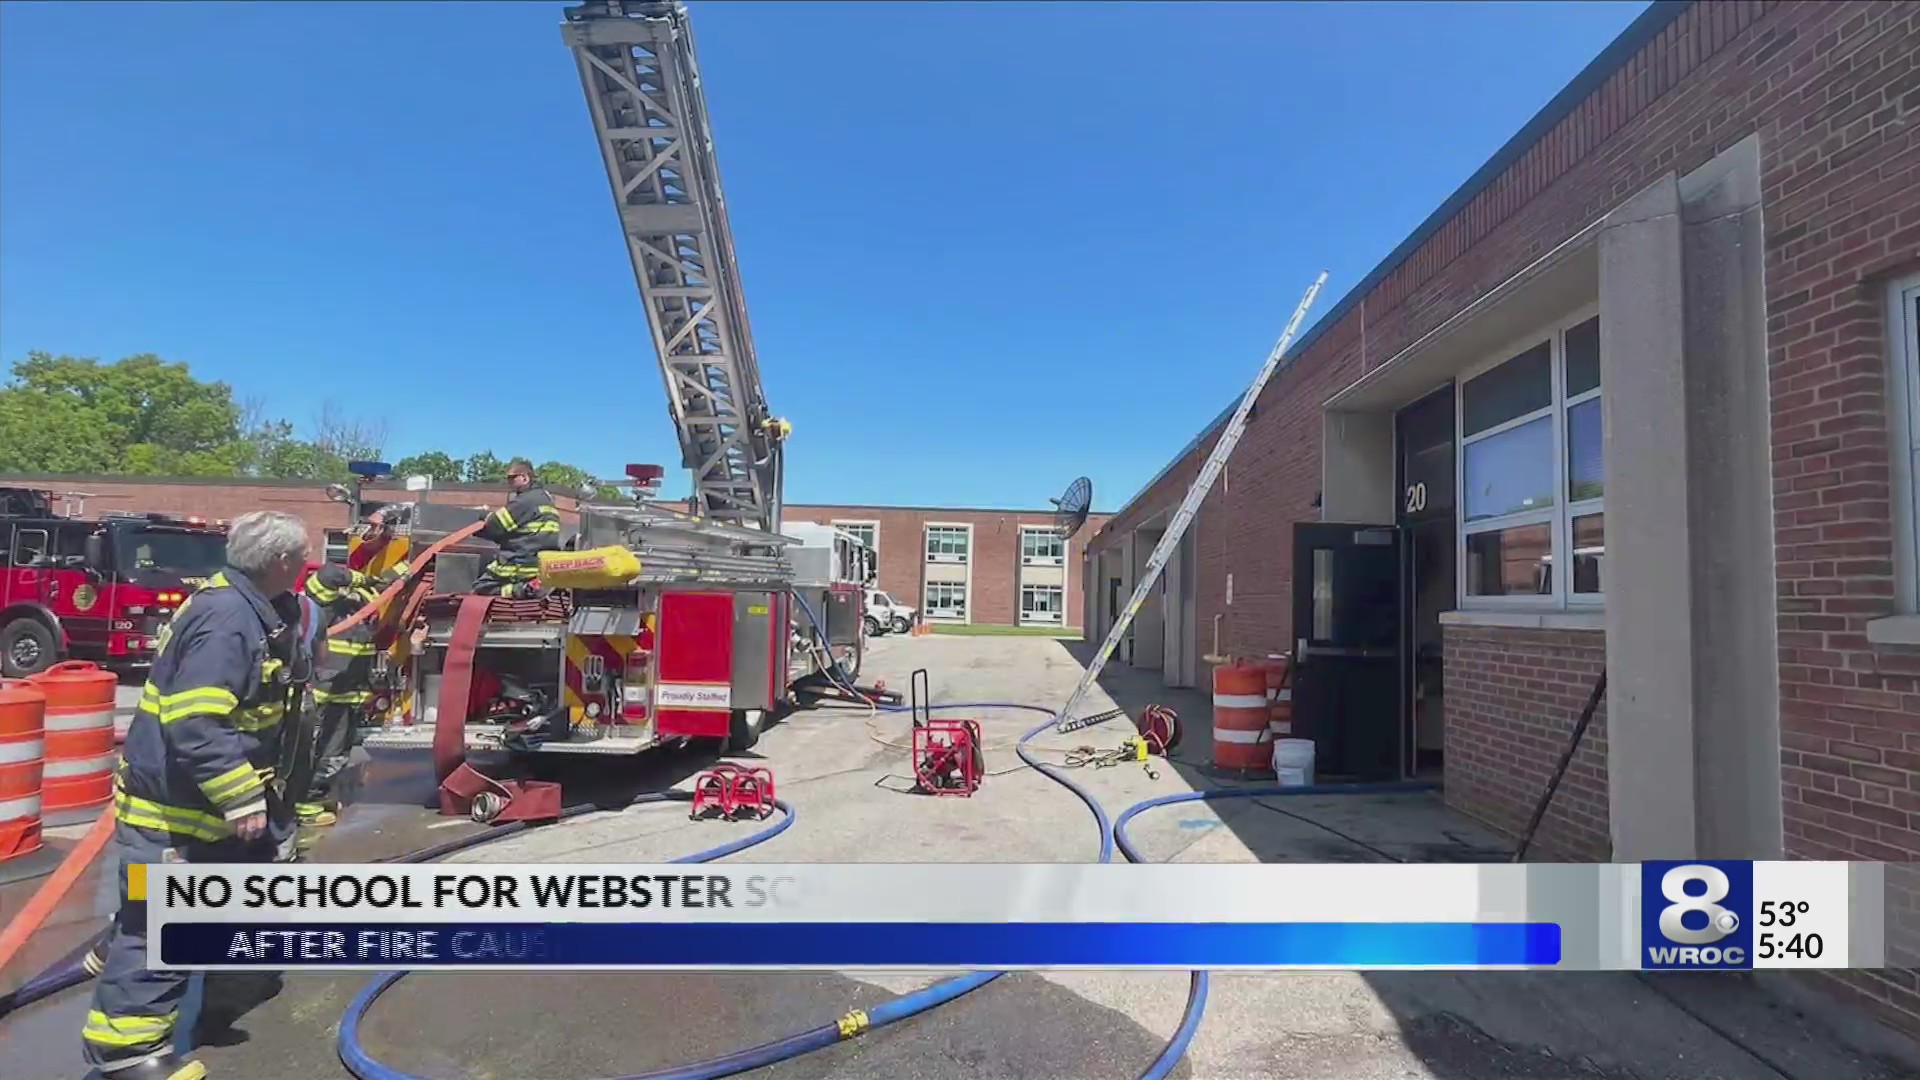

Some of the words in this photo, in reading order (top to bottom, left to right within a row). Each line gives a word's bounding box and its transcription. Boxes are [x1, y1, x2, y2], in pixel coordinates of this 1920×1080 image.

[1407, 482, 1426, 512] 20
[661, 690, 695, 702] Proudly
[696, 691, 728, 702] Staffed
